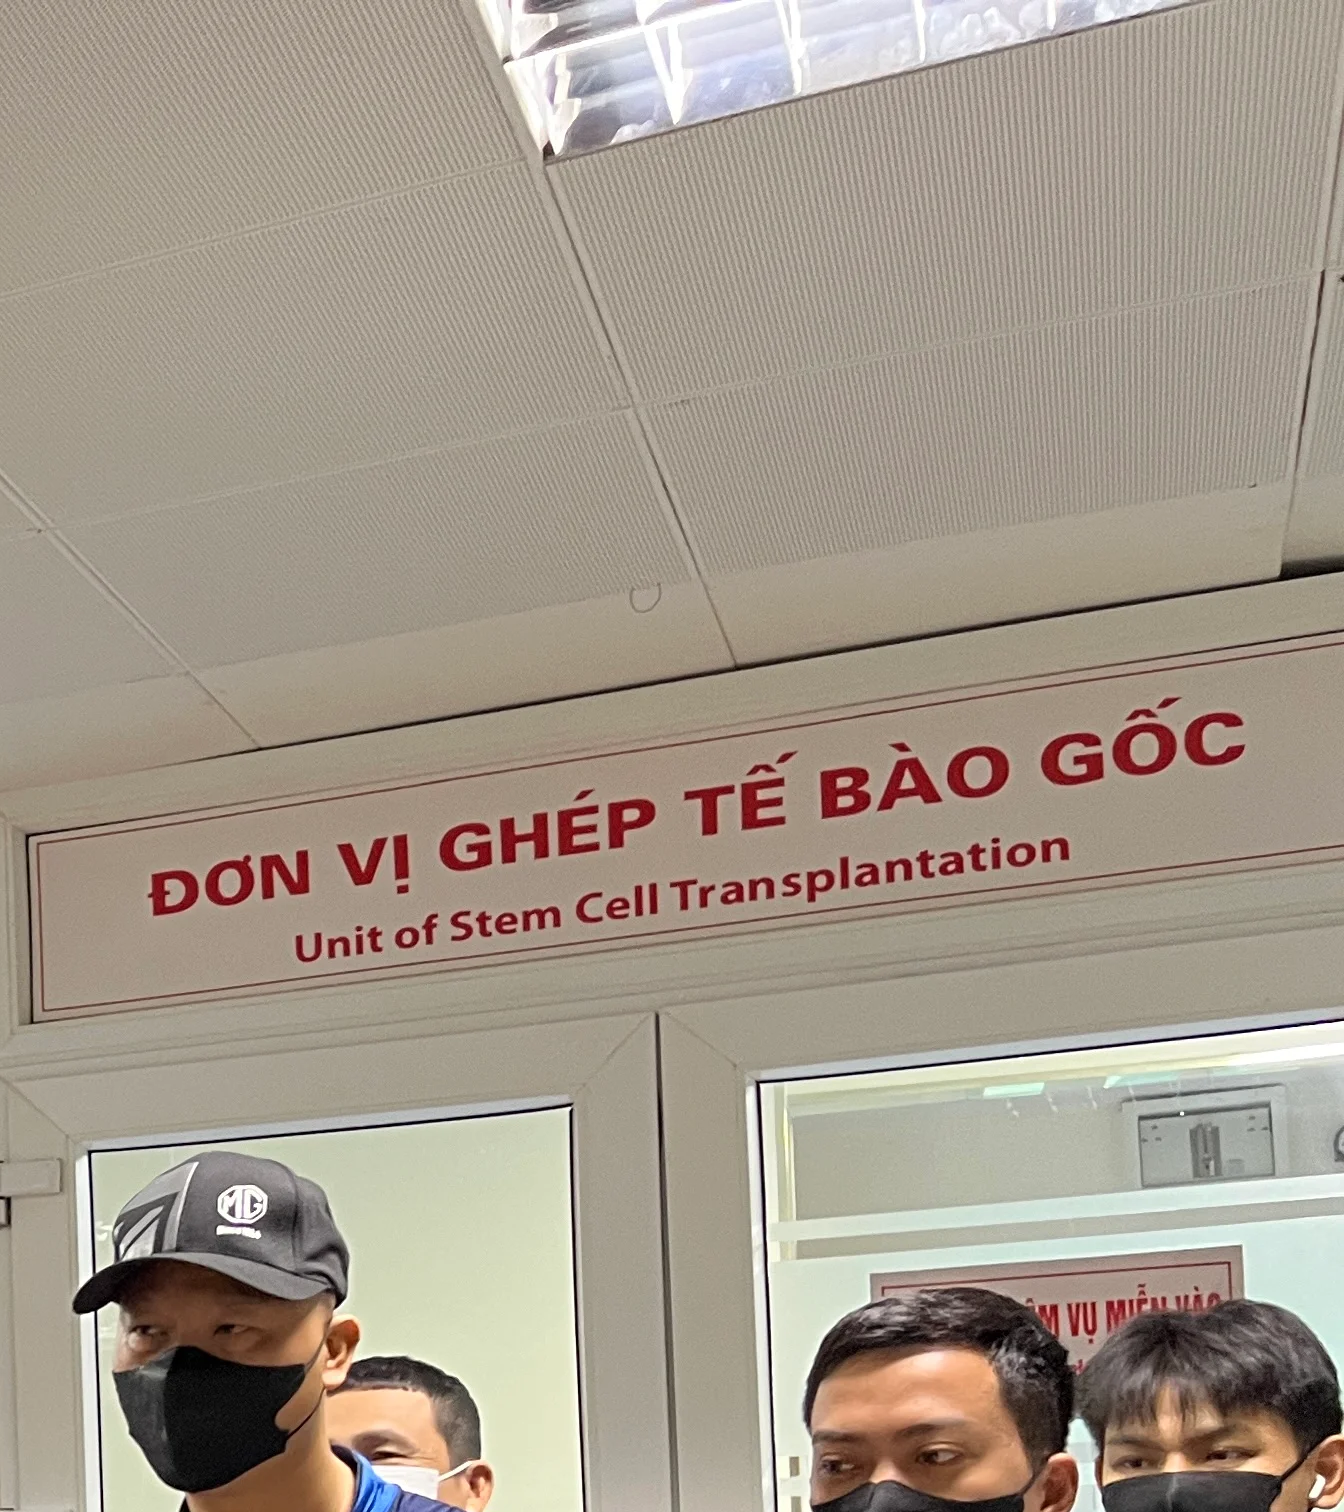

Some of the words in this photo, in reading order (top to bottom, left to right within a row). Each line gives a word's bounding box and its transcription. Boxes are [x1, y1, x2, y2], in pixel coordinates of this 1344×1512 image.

[148, 849, 312, 918] ĐƠN
[336, 833, 412, 897] VỊ
[438, 788, 658, 874] GHÉP
[683, 751, 798, 838] TẾ
[818, 741, 1012, 821] BÀO
[1040, 695, 1246, 788] GỐC
[294, 925, 385, 964] Unit
[393, 912, 440, 951] of
[448, 904, 563, 943] Stem
[575, 882, 660, 925] Cell
[669, 836, 1072, 913] Transplantation
[220, 1187, 265, 1221] MG
[1066, 1301, 1098, 1344] VỤ
